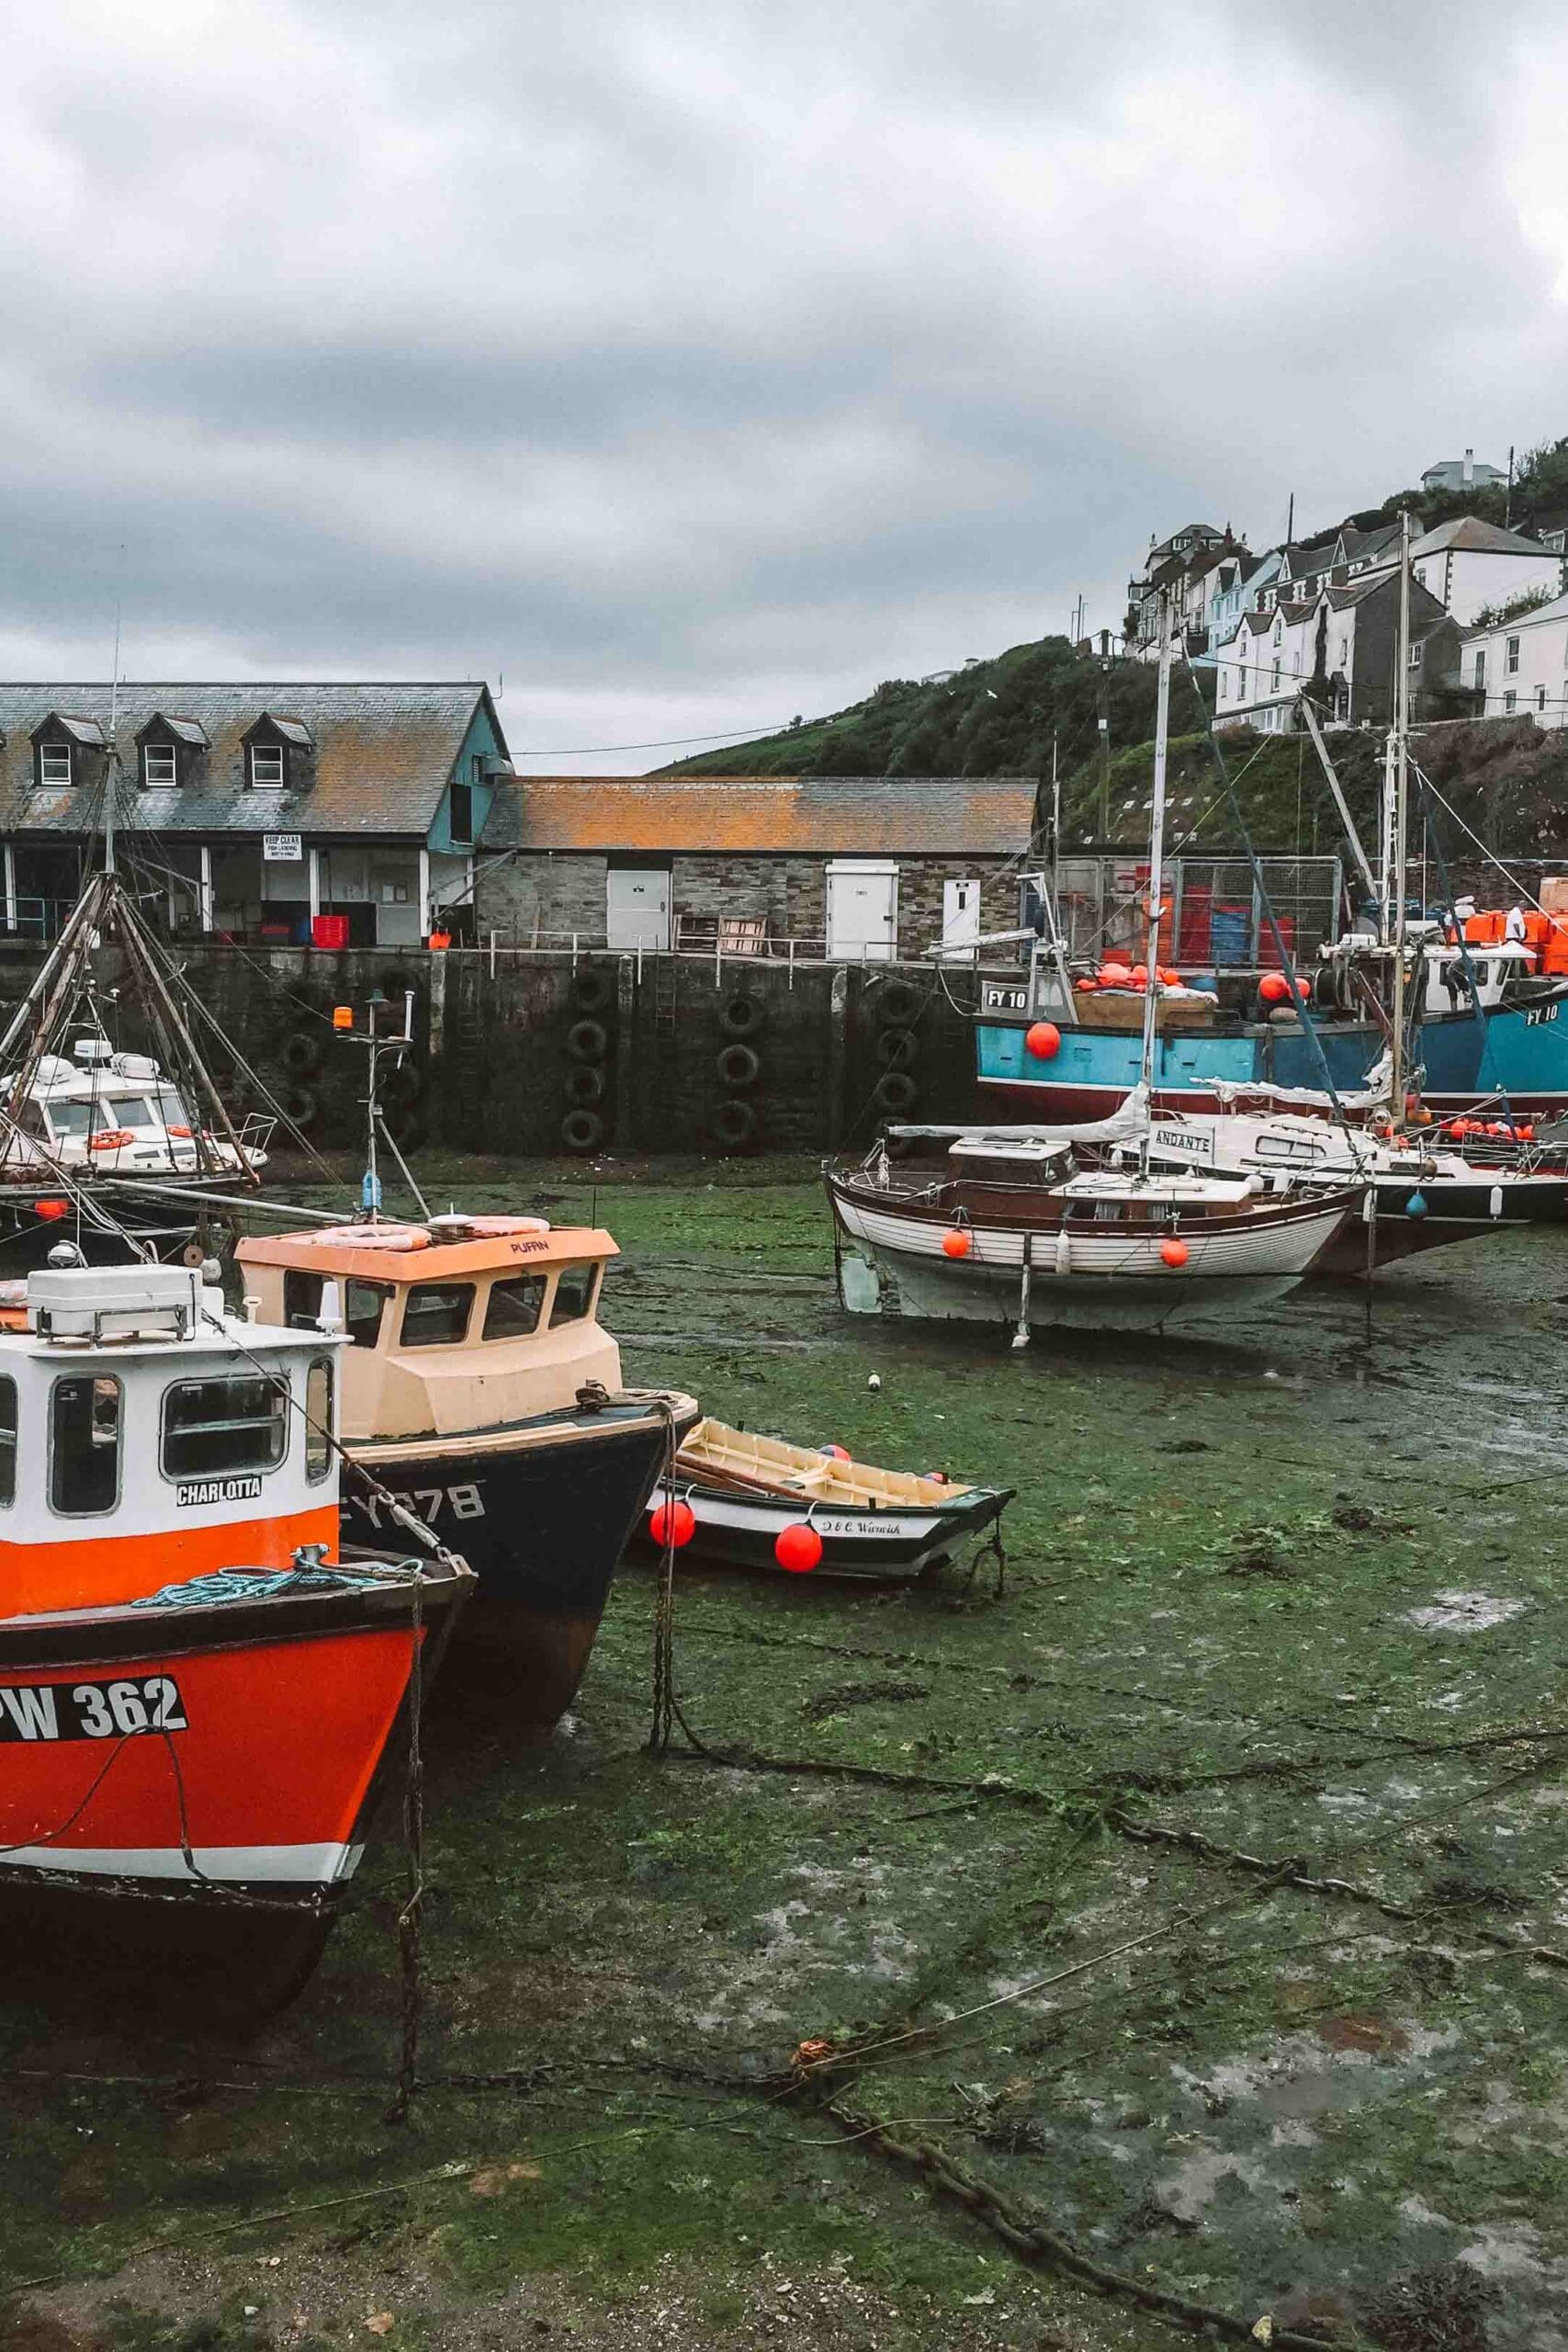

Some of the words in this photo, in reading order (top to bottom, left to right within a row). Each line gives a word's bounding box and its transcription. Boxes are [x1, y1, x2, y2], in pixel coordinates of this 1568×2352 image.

[265, 836, 279, 844] KEEP
[280, 836, 299, 844] CLEAR
[988, 989, 1006, 1006] FY
[1009, 991, 1026, 1009] 10
[1527, 1008, 1542, 1026] FY
[1545, 1004, 1558, 1021] 10
[1156, 1130, 1210, 1153] ANDANTE
[510, 1240, 549, 1253] PUFFIN
[177, 1477, 262, 1505] CHARLOTTA
[0, 1687, 59, 1740] W
[73, 1678, 187, 1737] 362
